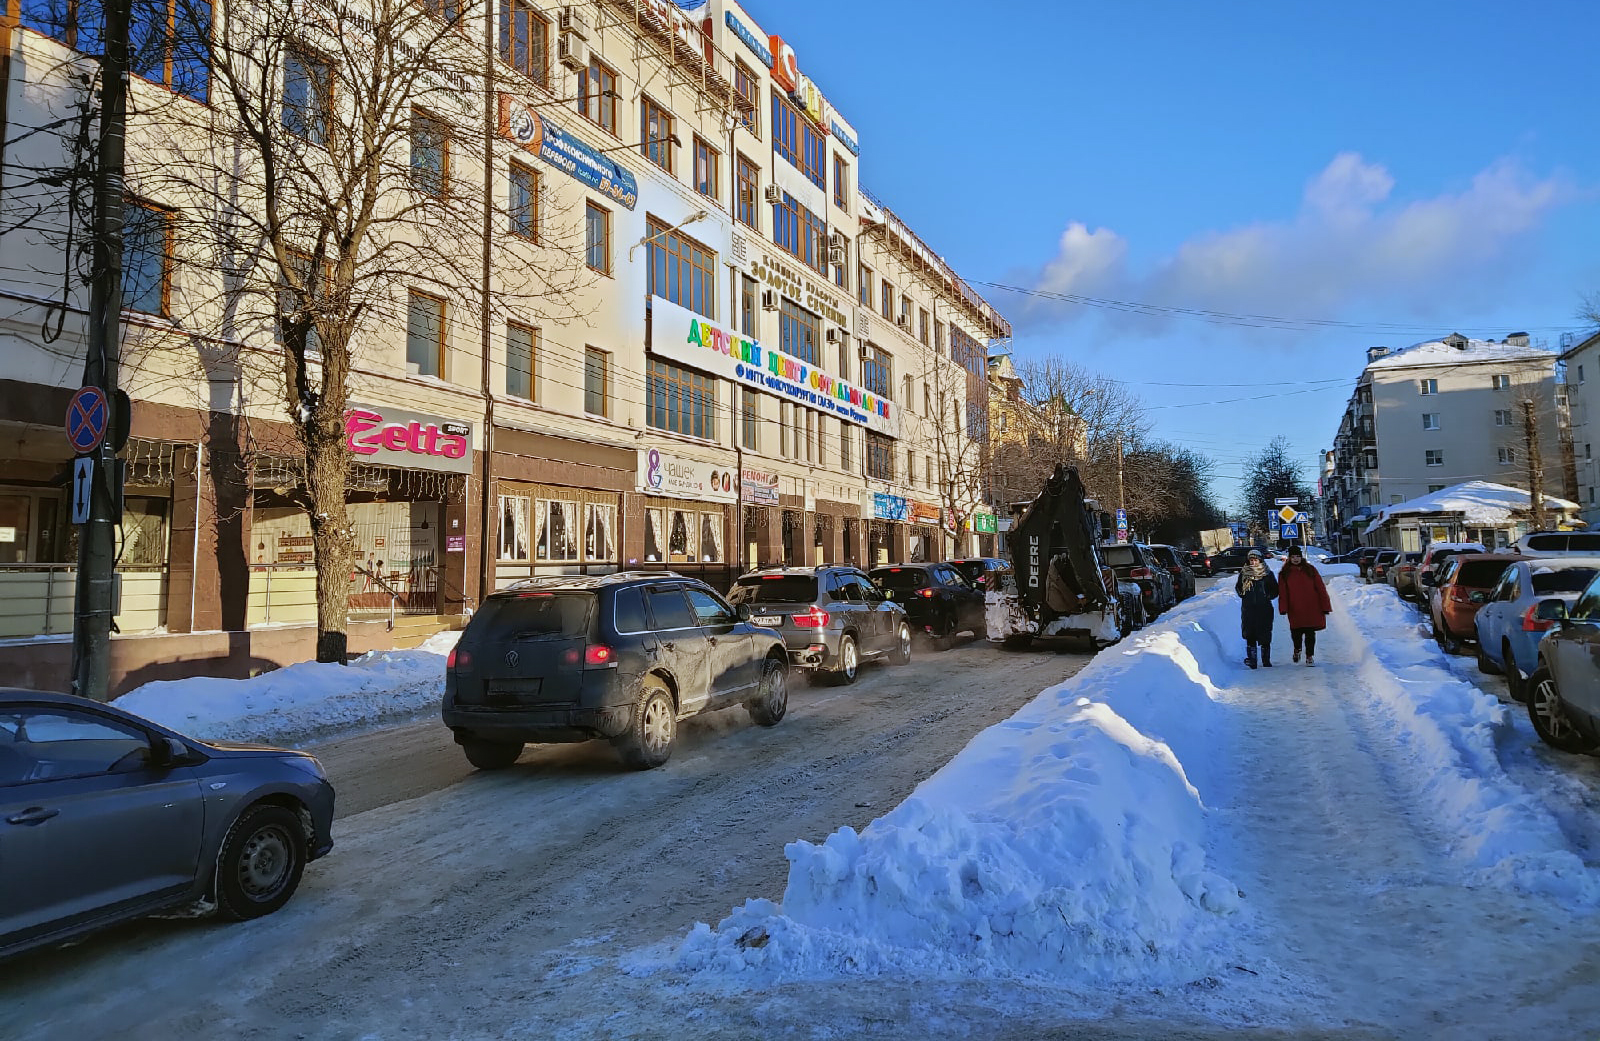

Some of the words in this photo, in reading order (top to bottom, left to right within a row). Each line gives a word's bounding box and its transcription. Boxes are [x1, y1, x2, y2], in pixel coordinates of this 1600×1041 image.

[751, 260, 802, 302] ЗОЛОТОЕ
[687, 318, 761, 367] ДЕТСКИЙ
[768, 351, 807, 384] ЦЕНТР
[810, 370, 890, 420] ОФТАЛЬМОЛОГИИ
[343, 407, 467, 459] Zetta
[447, 425, 469, 435] SPORT
[1029, 535, 1039, 588] DEERE
